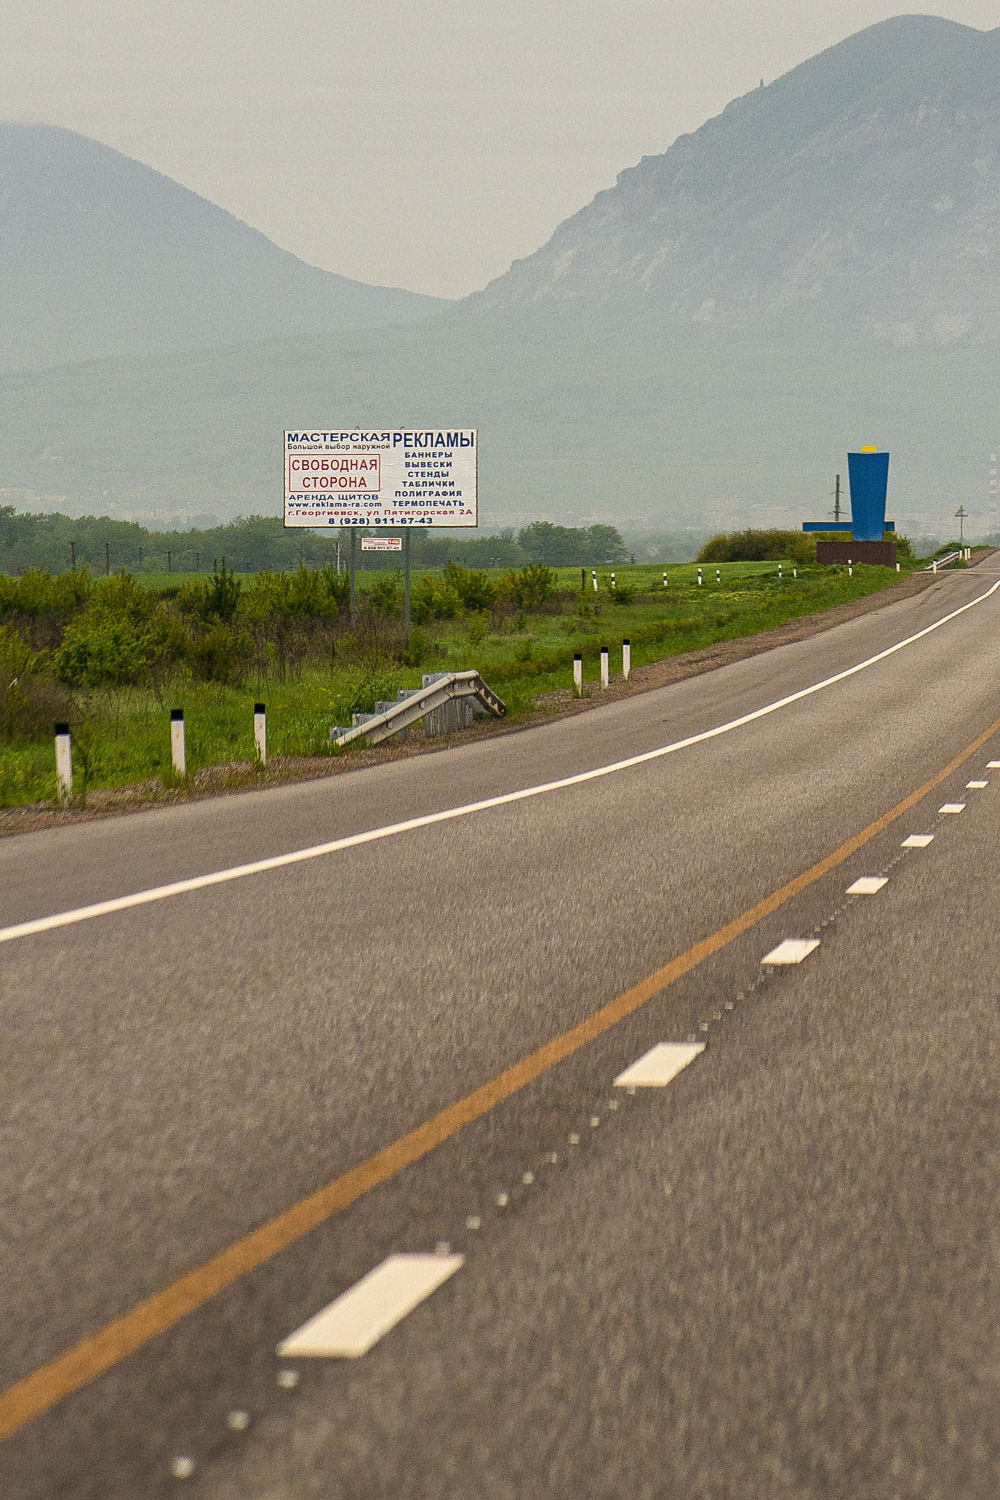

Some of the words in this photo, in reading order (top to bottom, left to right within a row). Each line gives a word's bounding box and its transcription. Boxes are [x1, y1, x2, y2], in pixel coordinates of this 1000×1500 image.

[288, 433, 390, 442] МАСТЕРСКАЯ
[393, 432, 474, 448] РЕКЛАМЫ
[292, 460, 378, 472] СВОБОДНАЯ
[302, 476, 367, 488] СТОРОНА
